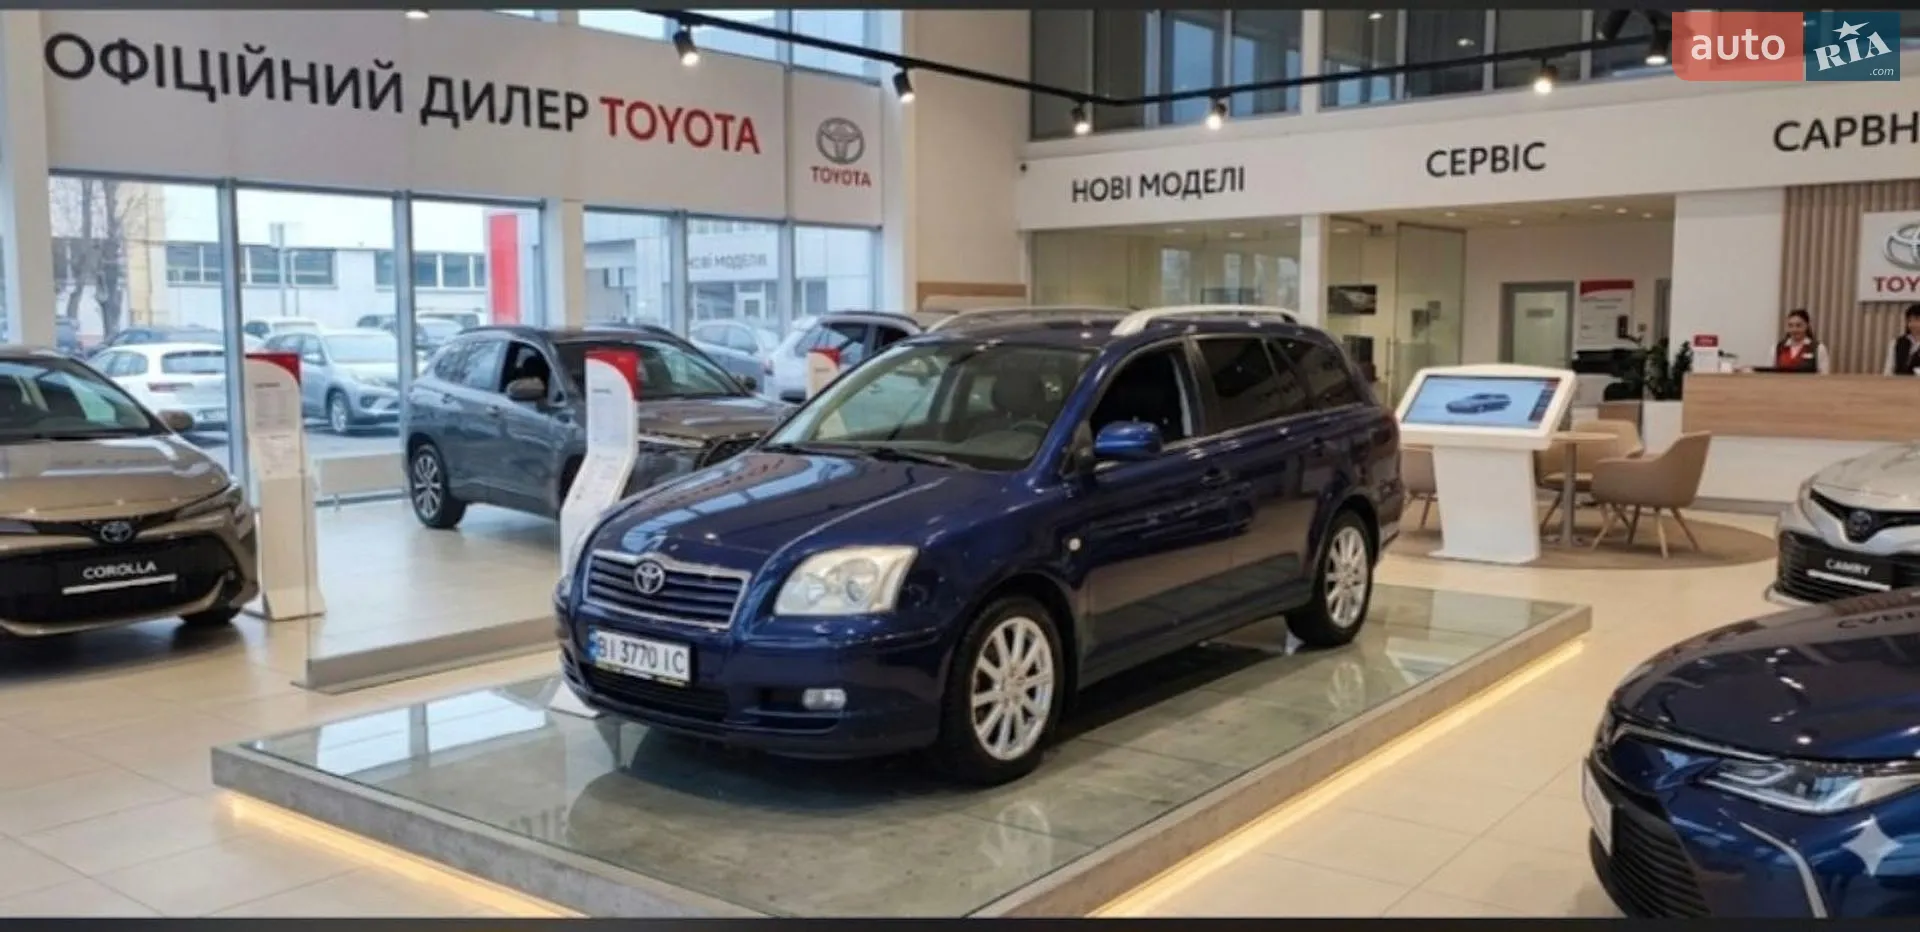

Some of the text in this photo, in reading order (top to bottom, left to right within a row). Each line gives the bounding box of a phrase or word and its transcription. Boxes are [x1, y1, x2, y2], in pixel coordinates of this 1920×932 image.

[44, 32, 761, 154] ОФІЦІЙНИЙ ДИЛЕР TOYOTA
[1773, 111, 1920, 152] САРВН
[1426, 141, 1547, 178] СЕРВІС
[811, 165, 871, 187] TOYOTA
[1072, 166, 1245, 202] НОВІ МОДЕЛІ
[83, 561, 157, 579] COROLLA
[1826, 559, 1872, 576] CAMRY
[620, 641, 658, 668] 3770
